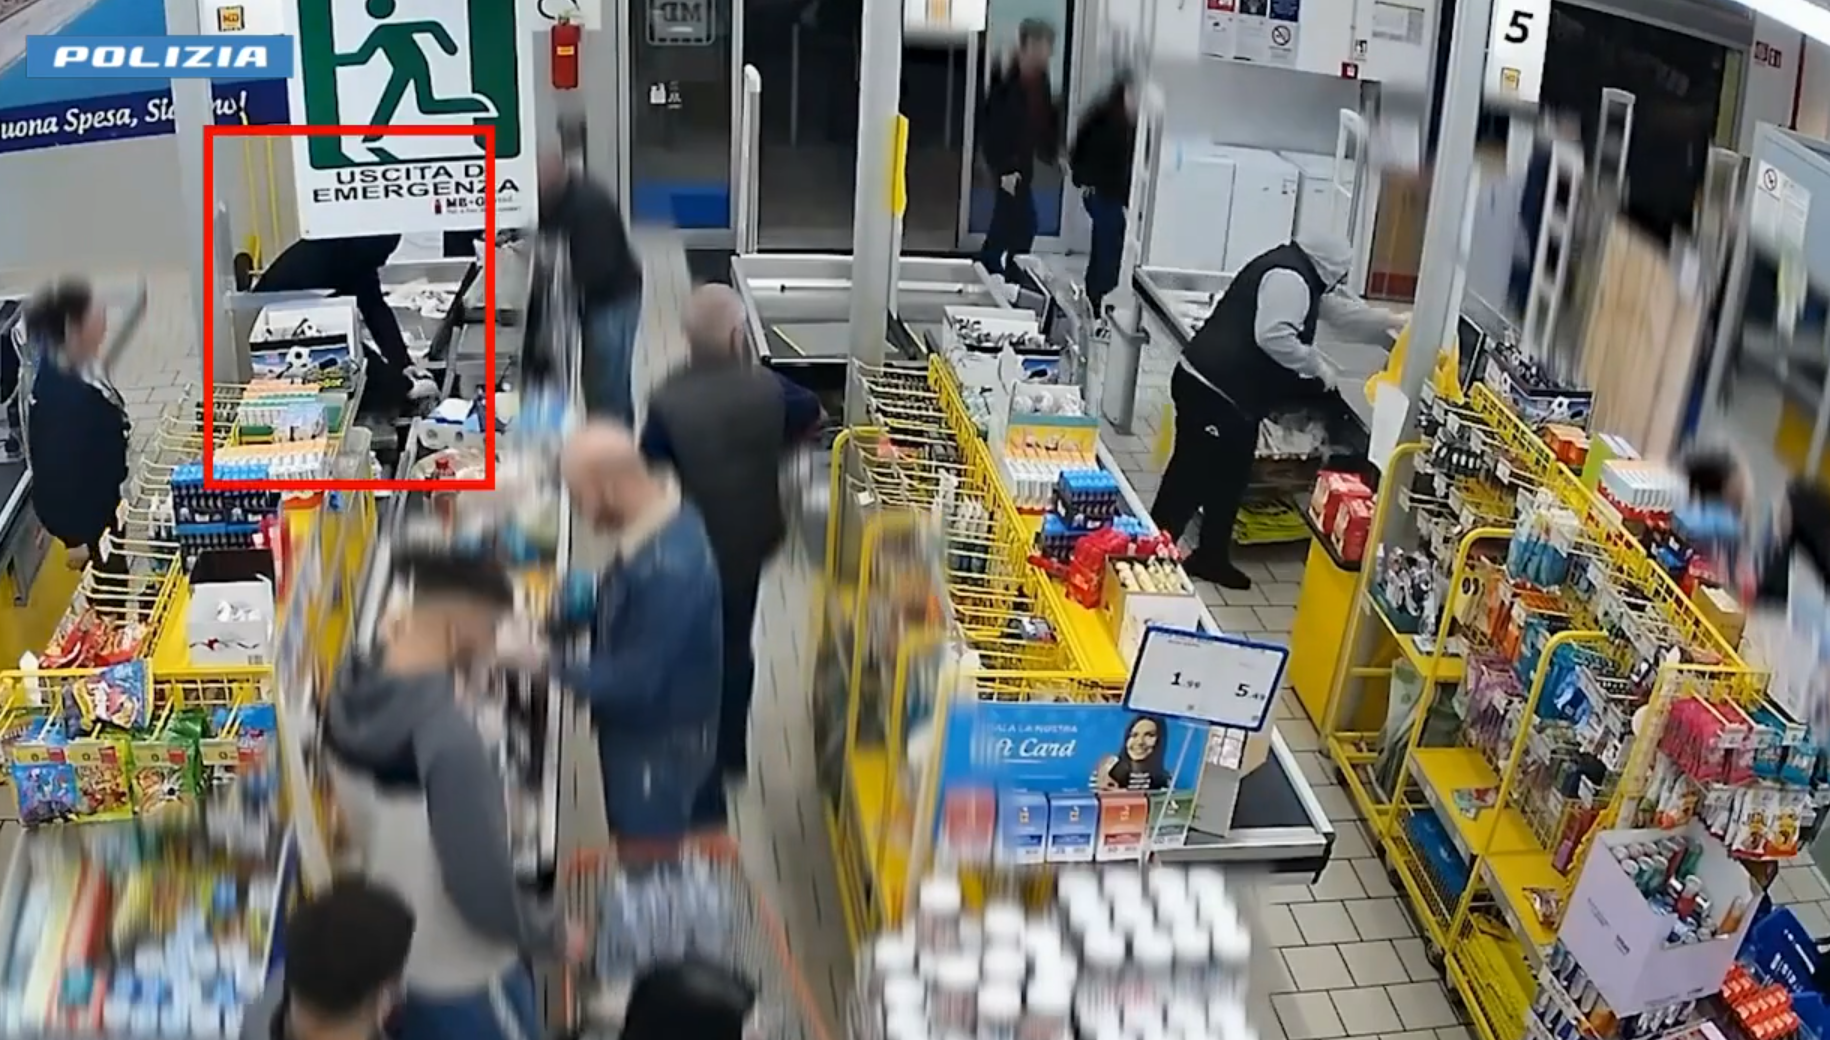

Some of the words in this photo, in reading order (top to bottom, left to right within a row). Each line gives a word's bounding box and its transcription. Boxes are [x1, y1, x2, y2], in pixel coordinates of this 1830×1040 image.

[1504, 9, 1533, 44] 5
[0, 116, 59, 140] uona
[63, 107, 139, 135] Spesa,
[336, 165, 454, 185] USCITA
[465, 164, 485, 179] D
[1019, 737, 1077, 758] Card
